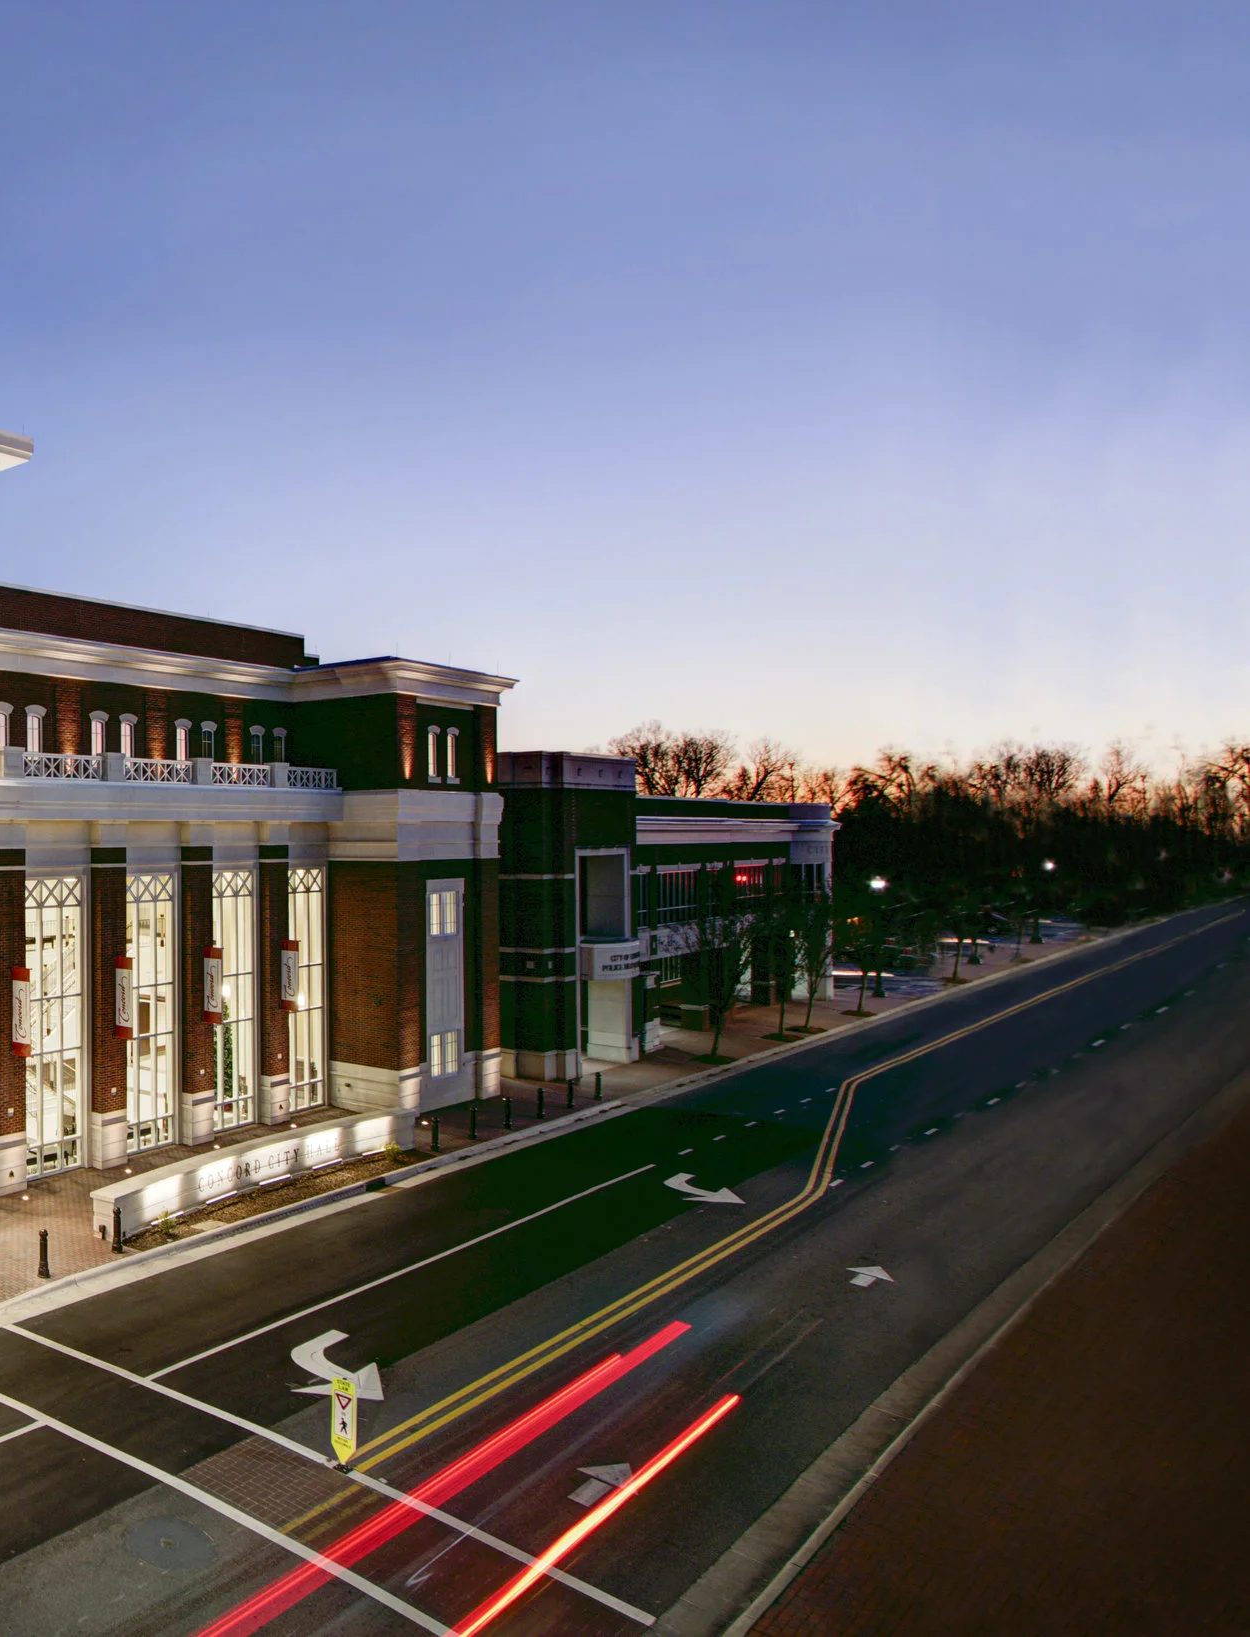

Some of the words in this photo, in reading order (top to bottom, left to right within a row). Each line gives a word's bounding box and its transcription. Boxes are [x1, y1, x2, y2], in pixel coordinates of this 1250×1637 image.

[15, 988, 27, 1041] Concord
[118, 976, 130, 1024] Concord
[198, 1159, 262, 1192] CONCORD
[268, 1147, 300, 1170] CITY
[306, 1138, 341, 1159] HALL
